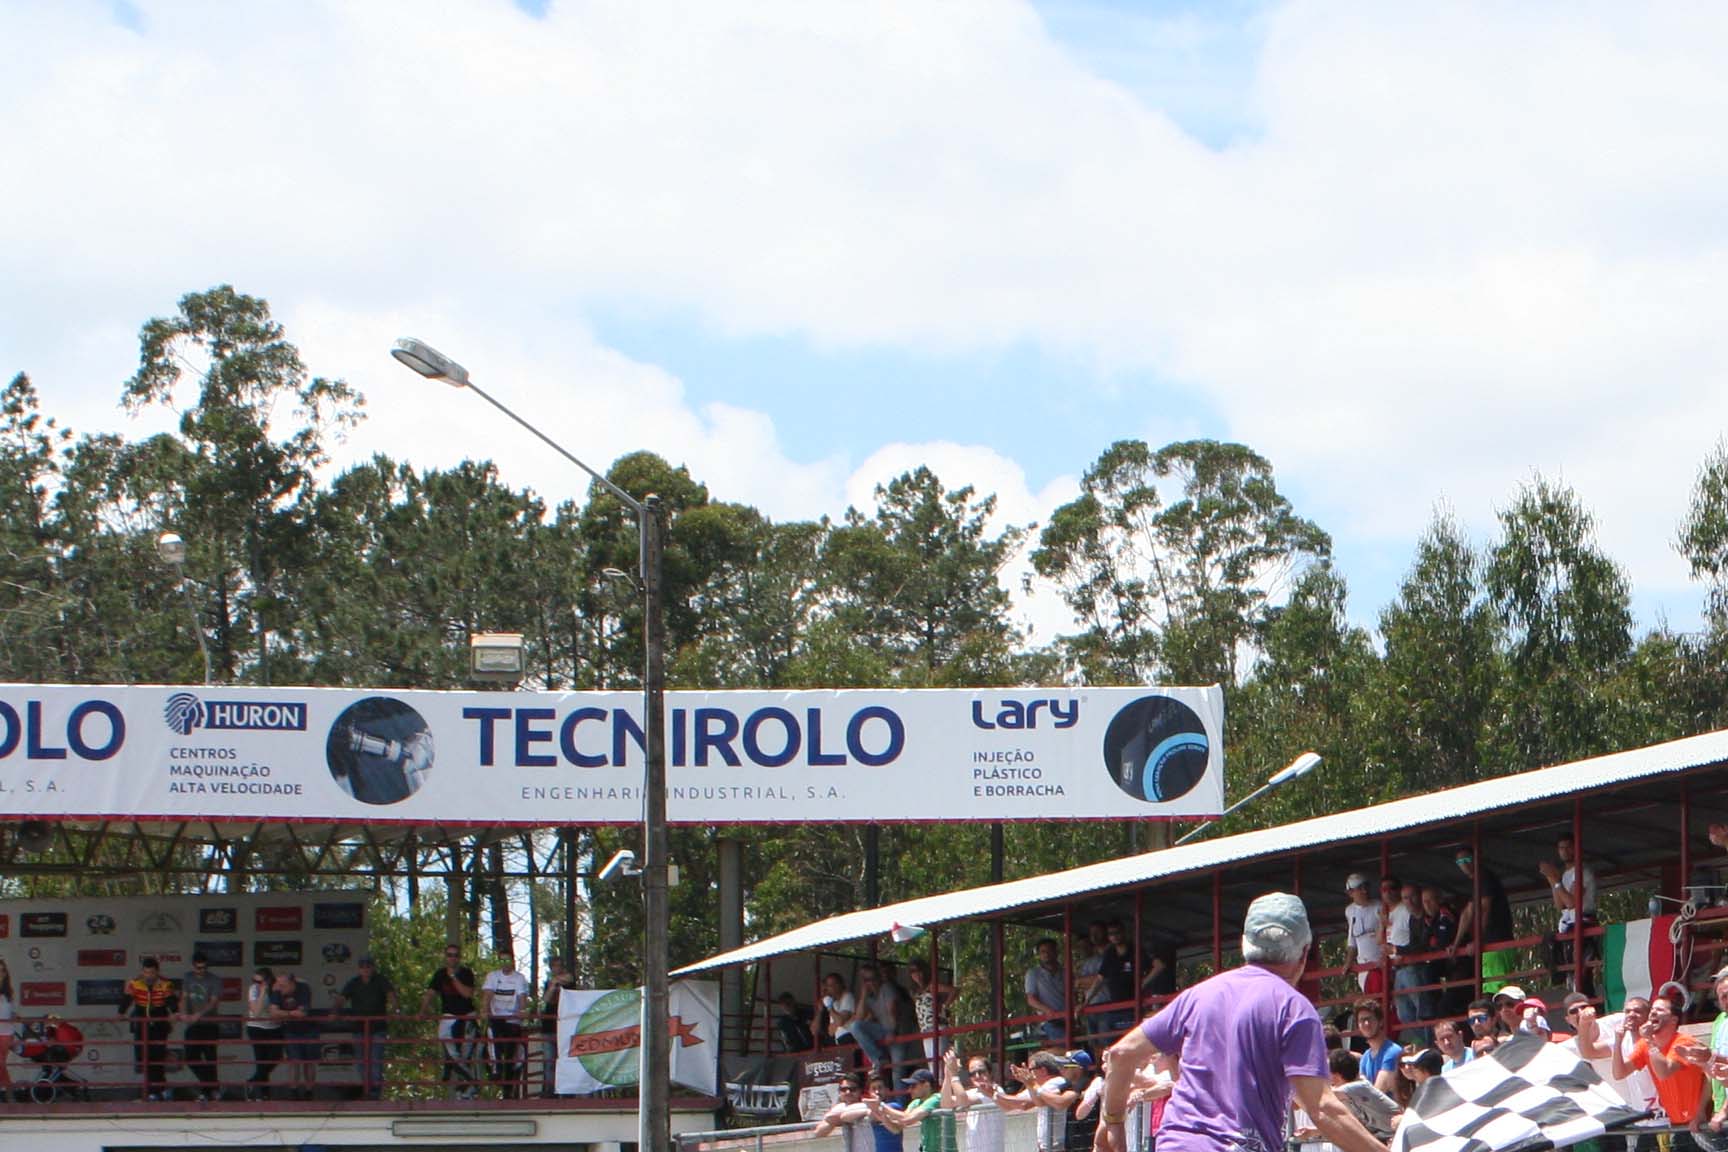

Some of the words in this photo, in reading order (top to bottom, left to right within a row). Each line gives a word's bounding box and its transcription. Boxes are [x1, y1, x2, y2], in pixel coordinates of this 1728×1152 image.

[215, 704, 299, 728] HURON
[462, 706, 905, 767] TECNIROLO
[169, 747, 237, 759] CENTROS
[973, 748, 1035, 765] INJEÇÃO
[169, 763, 271, 779] MAQUINAÇÃO
[973, 765, 1042, 779] PLÁSTICO
[25, 780, 66, 793] S.A.
[169, 781, 206, 793] ALTA
[210, 782, 303, 795] VELOCIDADE
[521, 785, 648, 800] ENGENHARI
[665, 785, 797, 801] INDUSTRIAL,
[807, 784, 848, 799] S.A.
[973, 786, 983, 797] E
[985, 785, 1066, 797] BORRACHA
